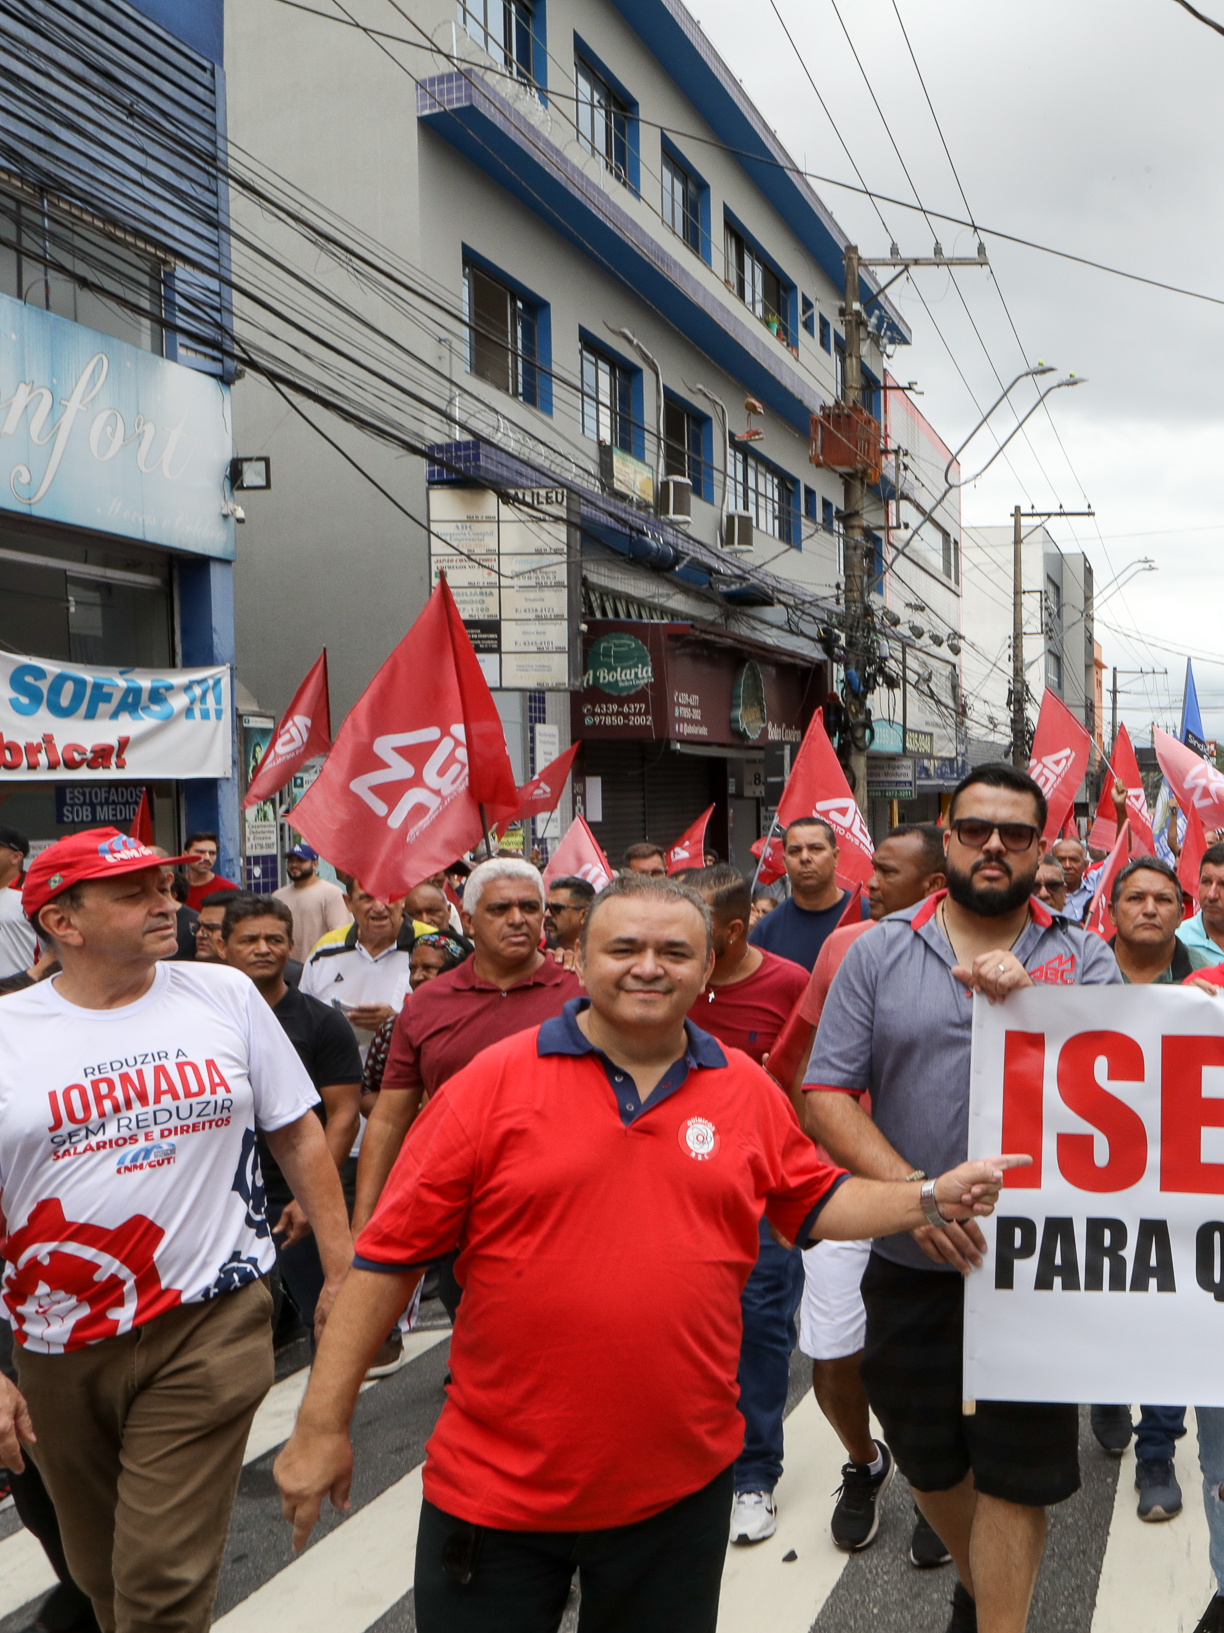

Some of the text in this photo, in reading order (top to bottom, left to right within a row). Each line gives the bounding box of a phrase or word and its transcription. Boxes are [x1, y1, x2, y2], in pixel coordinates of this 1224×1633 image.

[0, 352, 195, 505] nfort
[502, 489, 565, 505] ALILEU
[583, 664, 652, 689] A Bolaria
[9, 664, 175, 721] SOFÁS
[594, 703, 646, 714] 4339-6377
[594, 715, 652, 726] 97850-2002
[767, 721, 781, 740] Bolos
[66, 787, 144, 804] ESTOFADOS
[63, 805, 138, 822] SOB MEDID
[1028, 965, 1075, 984] ABC
[84, 1048, 188, 1078] REDUZIR A
[48, 1058, 232, 1133] JORNADA
[51, 1098, 234, 1148] SEM REDUZIR
[52, 1116, 232, 1161] SALÁRIOS E DIREITOS
[994, 1216, 1177, 1293] PARA
